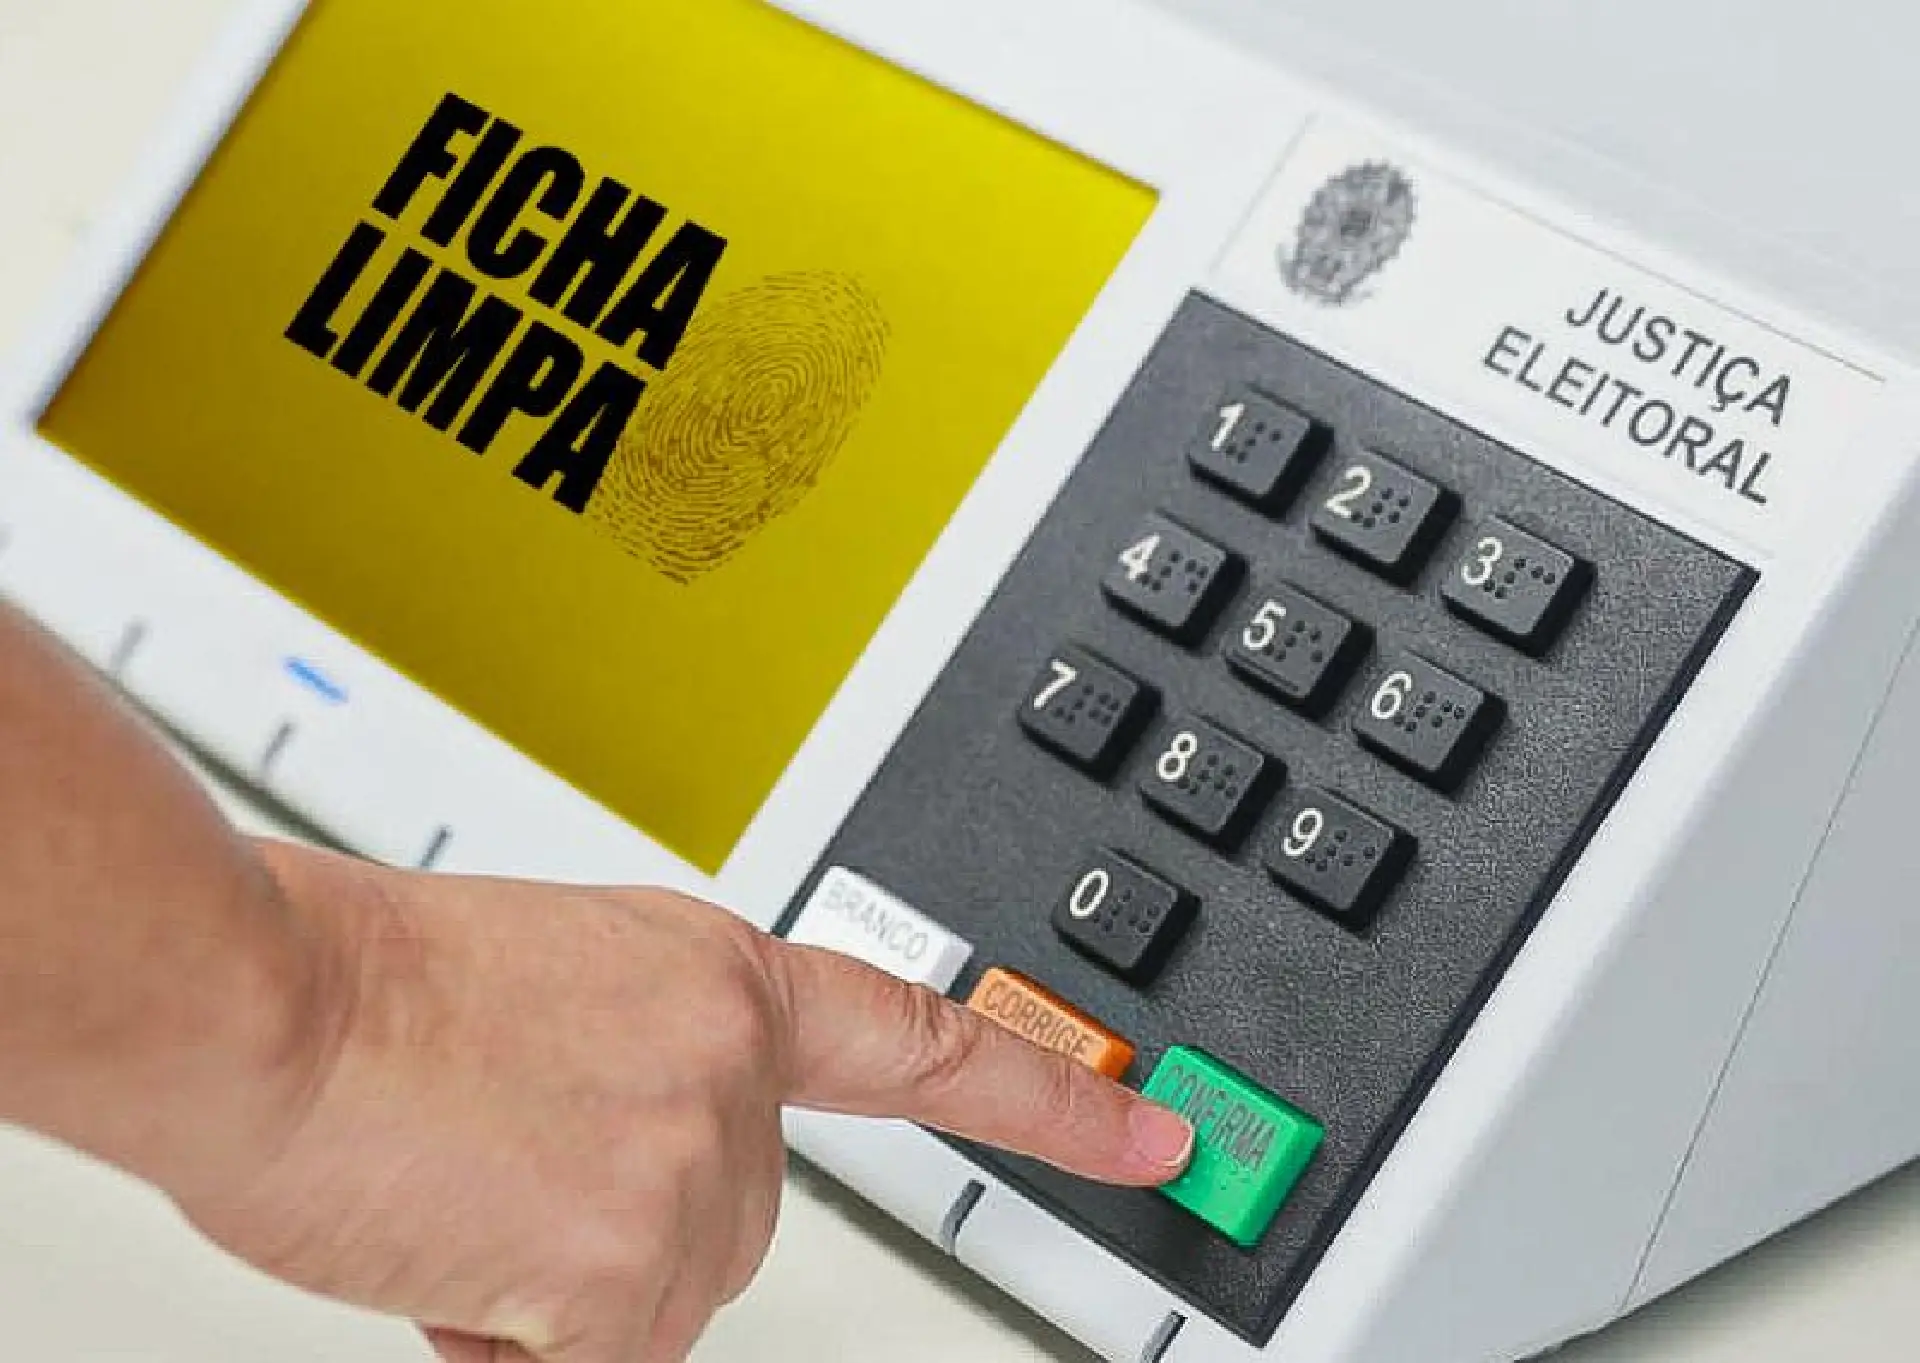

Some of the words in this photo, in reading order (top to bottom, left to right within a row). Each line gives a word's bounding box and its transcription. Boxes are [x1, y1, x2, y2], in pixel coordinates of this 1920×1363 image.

[372, 93, 727, 371] FICHA
[285, 222, 648, 514] LIMPA
[1567, 289, 1790, 425] JUSTIÇA
[1211, 403, 1244, 451] 1
[1482, 326, 1771, 504] ELEITORAL
[1325, 466, 1371, 518] 2
[1118, 532, 1161, 581] 4
[1460, 536, 1503, 585] 3
[1242, 600, 1286, 650] 5
[1033, 659, 1077, 708] 7
[1371, 671, 1412, 719] 6
[1156, 731, 1198, 782] 8
[1282, 807, 1323, 856] 9
[1069, 868, 1109, 917] 0
[822, 877, 928, 960] BRANCO
[984, 979, 1092, 1056] CORRIGE
[1156, 1064, 1276, 1173] CONFIRMA
